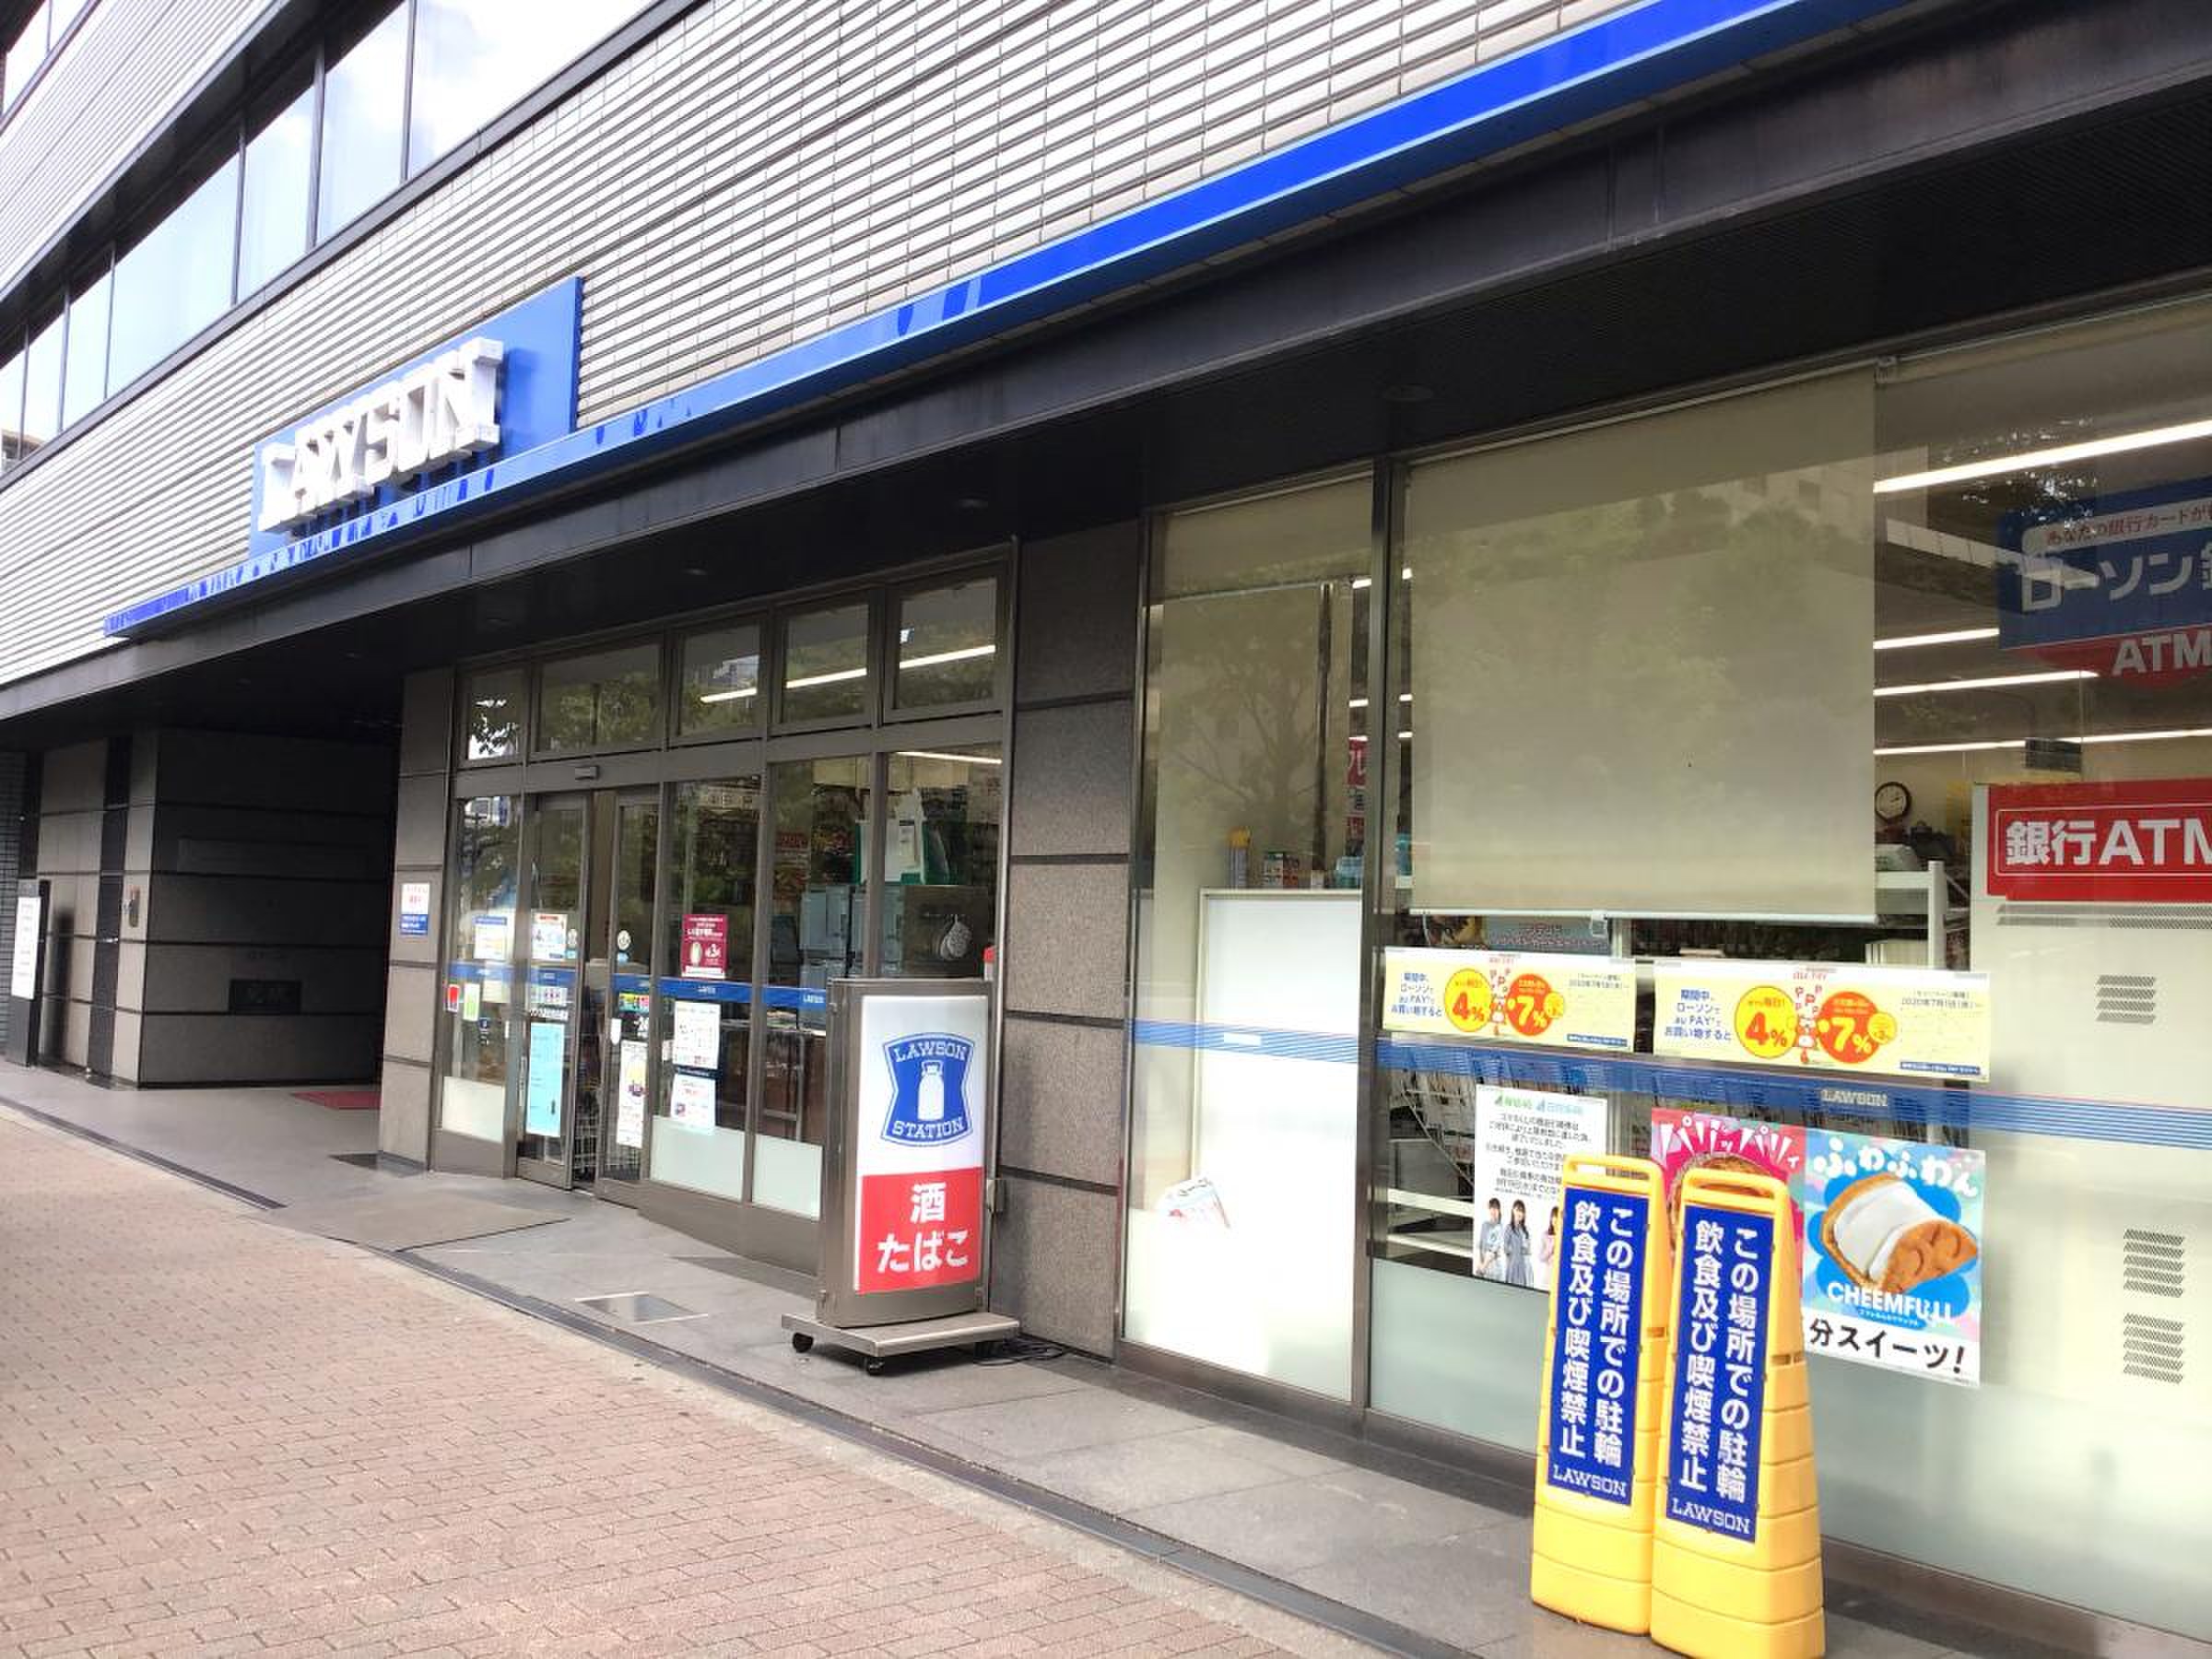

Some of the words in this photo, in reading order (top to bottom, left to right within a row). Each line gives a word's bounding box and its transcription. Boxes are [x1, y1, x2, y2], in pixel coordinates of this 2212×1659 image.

[258, 336, 503, 532] LAWSON
[2021, 542, 2212, 613] ローソン
[2112, 631, 2212, 676] ATM
[1745, 1011, 1788, 1048] 4%
[1830, 1017, 1873, 1054] 7%
[892, 1041, 969, 1064] LAWSON
[1820, 1088, 1888, 1107] LAWSON
[891, 1116, 964, 1140] STATION
[1813, 1136, 1979, 1197] ふわふわん
[910, 1182, 947, 1224] 酒
[877, 1229, 969, 1274] たばこ
[1559, 1199, 1602, 1460] 飲食及び喫煙禁止
[1593, 1206, 1634, 1468] この場所での駐輪
[1680, 1219, 1725, 1494] 飲食及び喫煙禁止
[1715, 1227, 1759, 1504] この場所での駐輪
[1553, 1464, 1627, 1499] LAWSON
[1671, 1498, 1751, 1535] LAWSON
